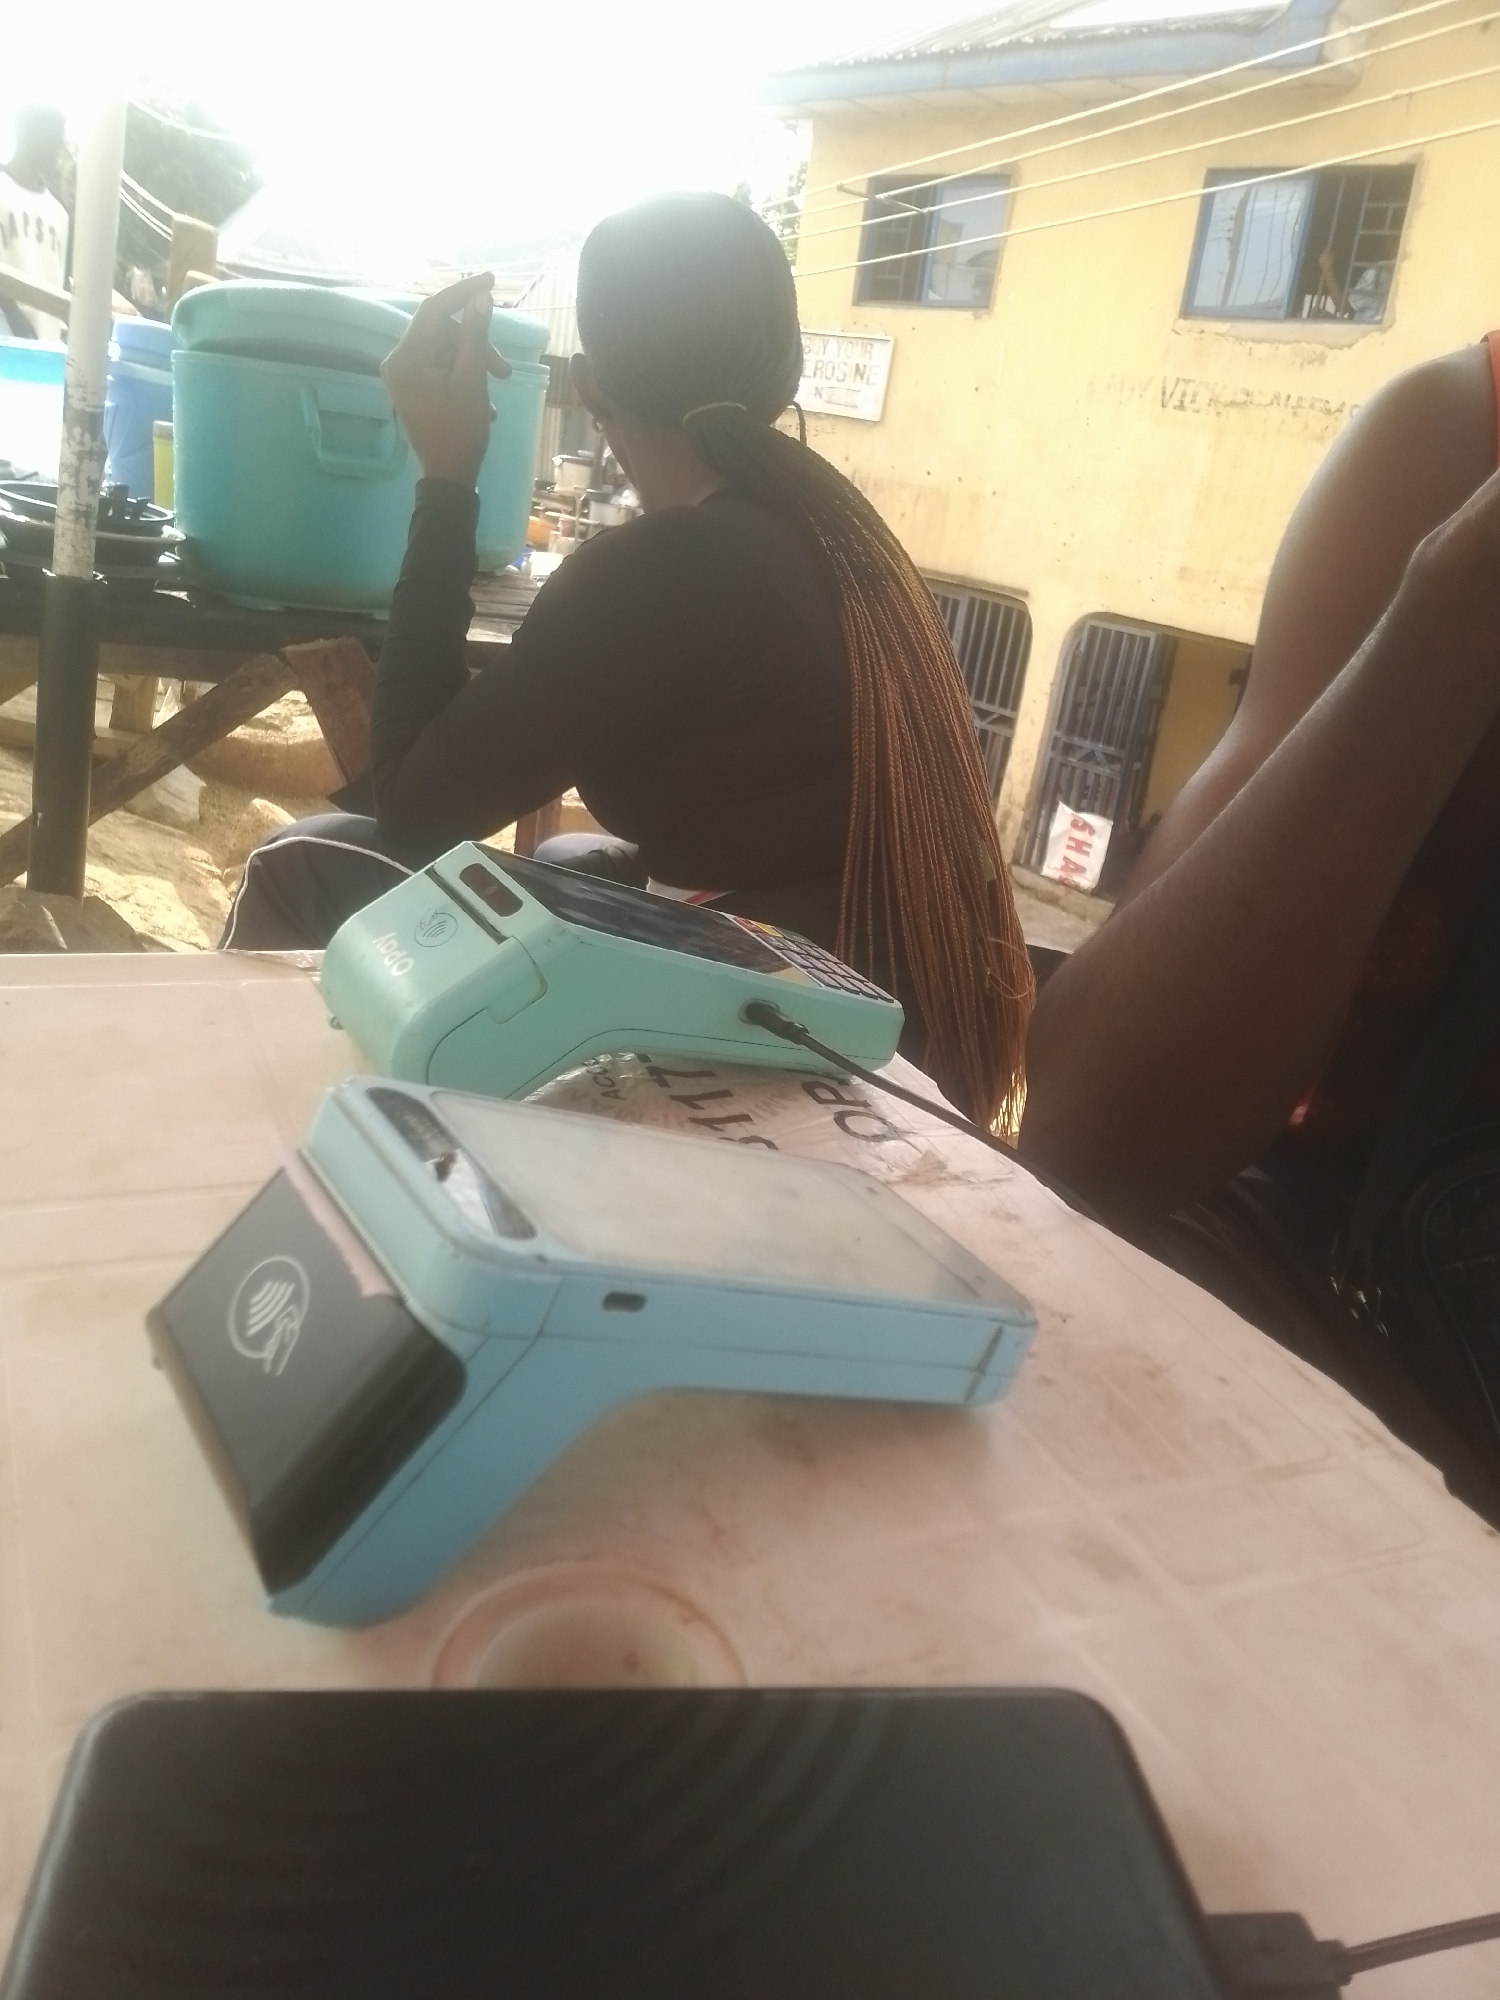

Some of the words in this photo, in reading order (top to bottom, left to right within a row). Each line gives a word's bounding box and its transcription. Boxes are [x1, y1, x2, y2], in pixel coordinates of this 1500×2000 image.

[802, 358, 880, 386] EROSINE
[373, 932, 414, 976] OPay
[784, 1070, 900, 1142] OP
